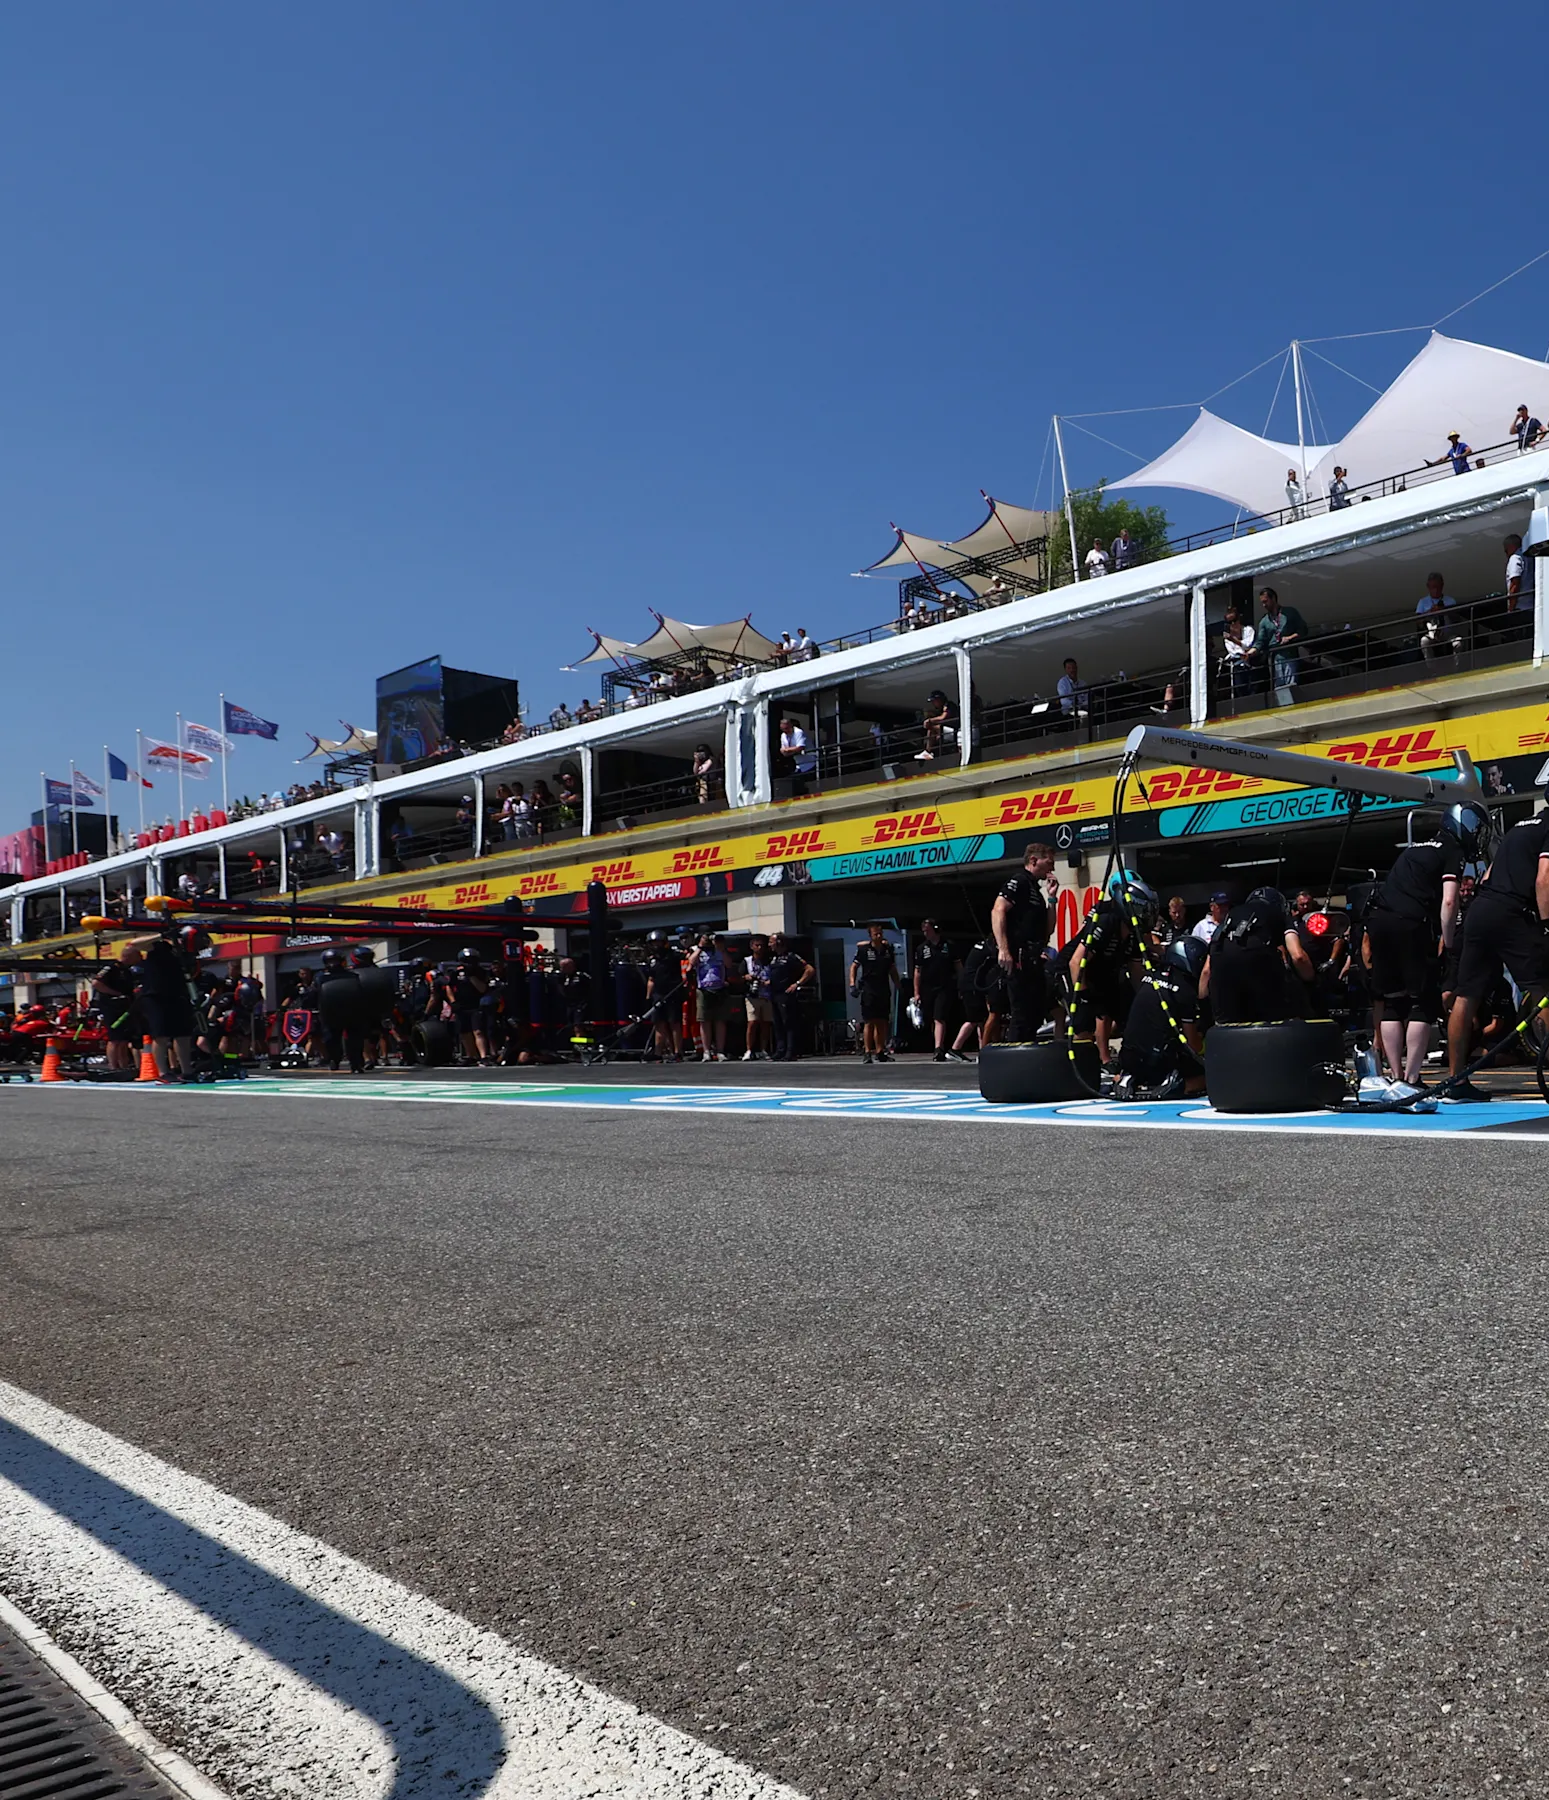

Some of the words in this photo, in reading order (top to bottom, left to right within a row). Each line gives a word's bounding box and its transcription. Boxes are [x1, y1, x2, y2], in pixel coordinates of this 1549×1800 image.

[1327, 730, 1443, 768] DHL
[1148, 768, 1244, 803] DHL
[999, 788, 1080, 824] DHL
[1240, 793, 1328, 824] GEORGE
[873, 812, 941, 843] DHL
[766, 830, 825, 859] DHL
[591, 861, 636, 883] DHL
[672, 846, 724, 873] DHL
[832, 857, 873, 877] LEWIS
[873, 844, 950, 870] HAMILTON
[520, 873, 561, 895] DHL
[753, 865, 784, 888] 44
[455, 884, 490, 905] DHL
[616, 882, 681, 905] VERSTAPPEN
